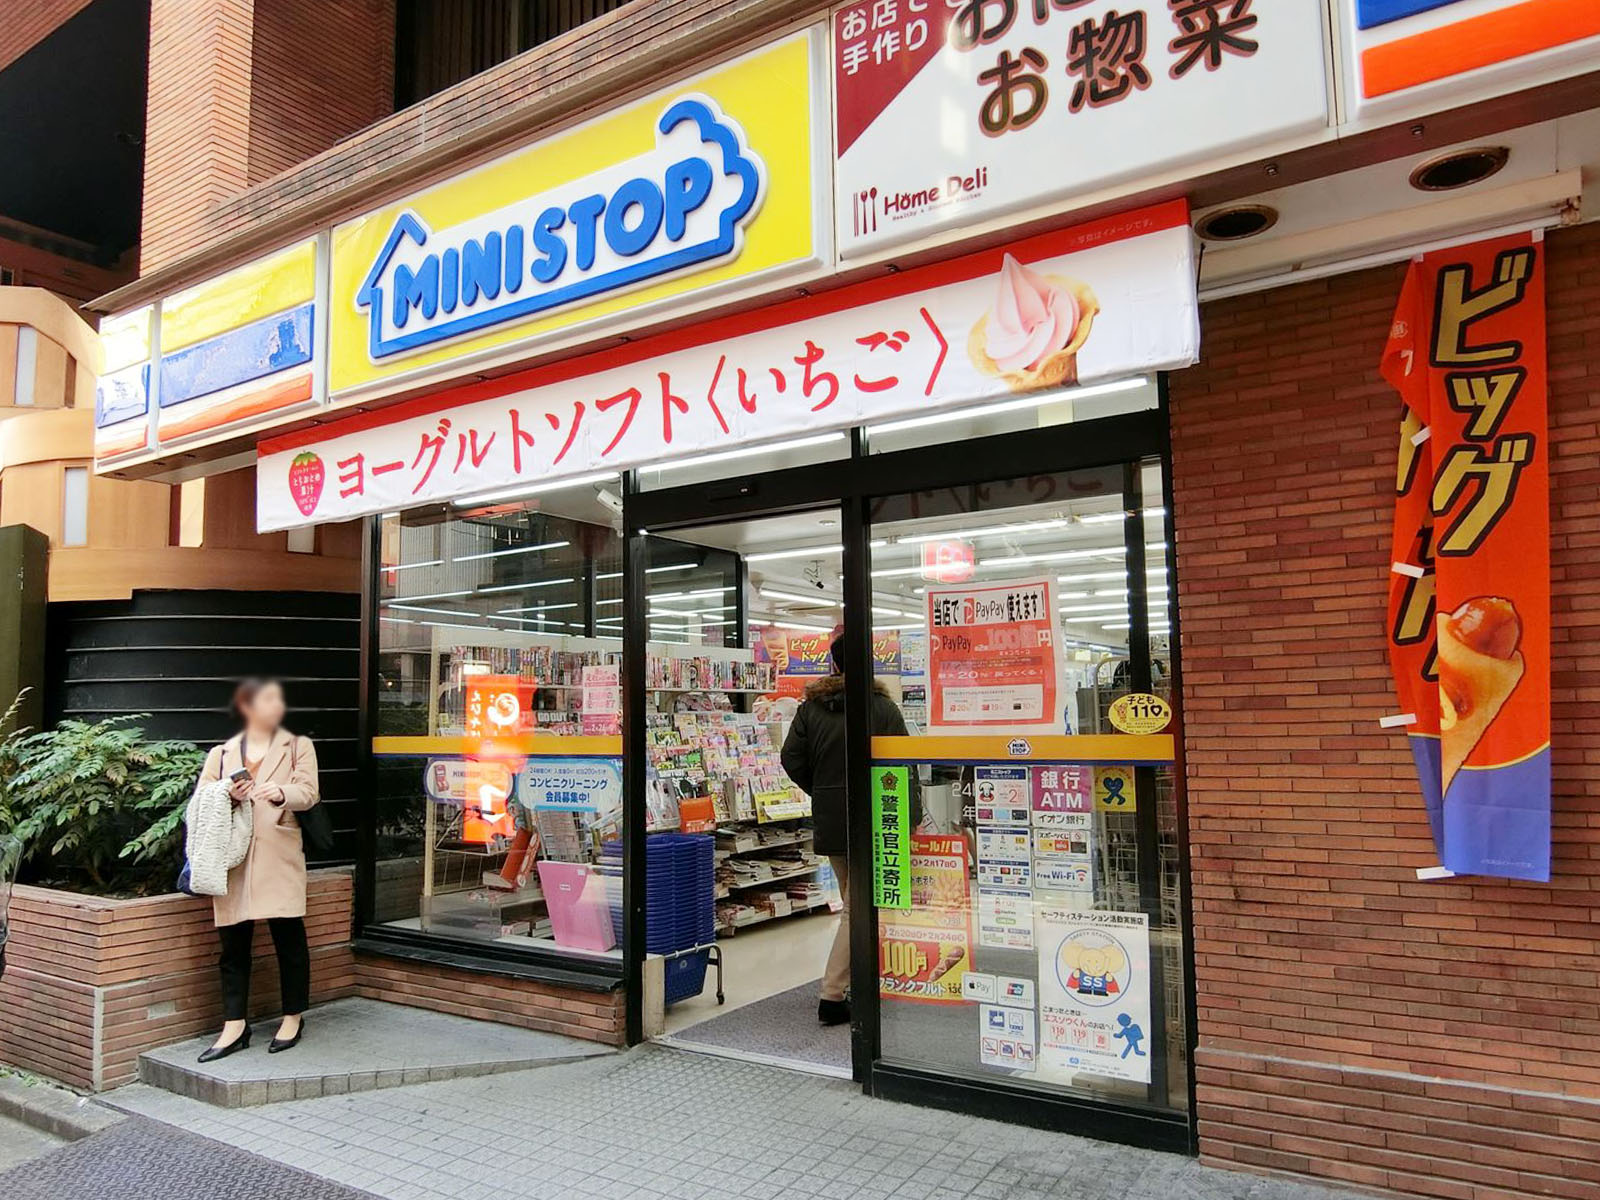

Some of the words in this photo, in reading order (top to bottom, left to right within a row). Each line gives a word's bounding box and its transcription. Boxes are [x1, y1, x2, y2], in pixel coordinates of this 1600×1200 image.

[842, 19, 929, 75] 手作り
[976, 0, 1261, 137] お惣菜
[884, 187, 940, 216] Home
[947, 167, 988, 197] Deli
[1431, 247, 1535, 556] ビッグ
[934, 598, 960, 626] 当店で
[976, 600, 1005, 621] PayPay
[791, 639, 819, 651] ビッグ
[942, 635, 972, 653] PayPay
[801, 650, 830, 662] ドッグ
[1127, 695, 1155, 705] 子ども
[530, 777, 608, 790] コンビニクリーニング
[1040, 770, 1080, 790] 銀行
[546, 791, 590, 803] 会員募集中!
[1040, 792, 1083, 808] ATM
[1039, 814, 1085, 825] イオン銀行
[881, 795, 901, 905] 警察官立寄所
[1052, 870, 1075, 880] Wi-Fi
[882, 940, 928, 978] 100円
[976, 982, 991, 993] Pay
[1083, 975, 1103, 987] SS
